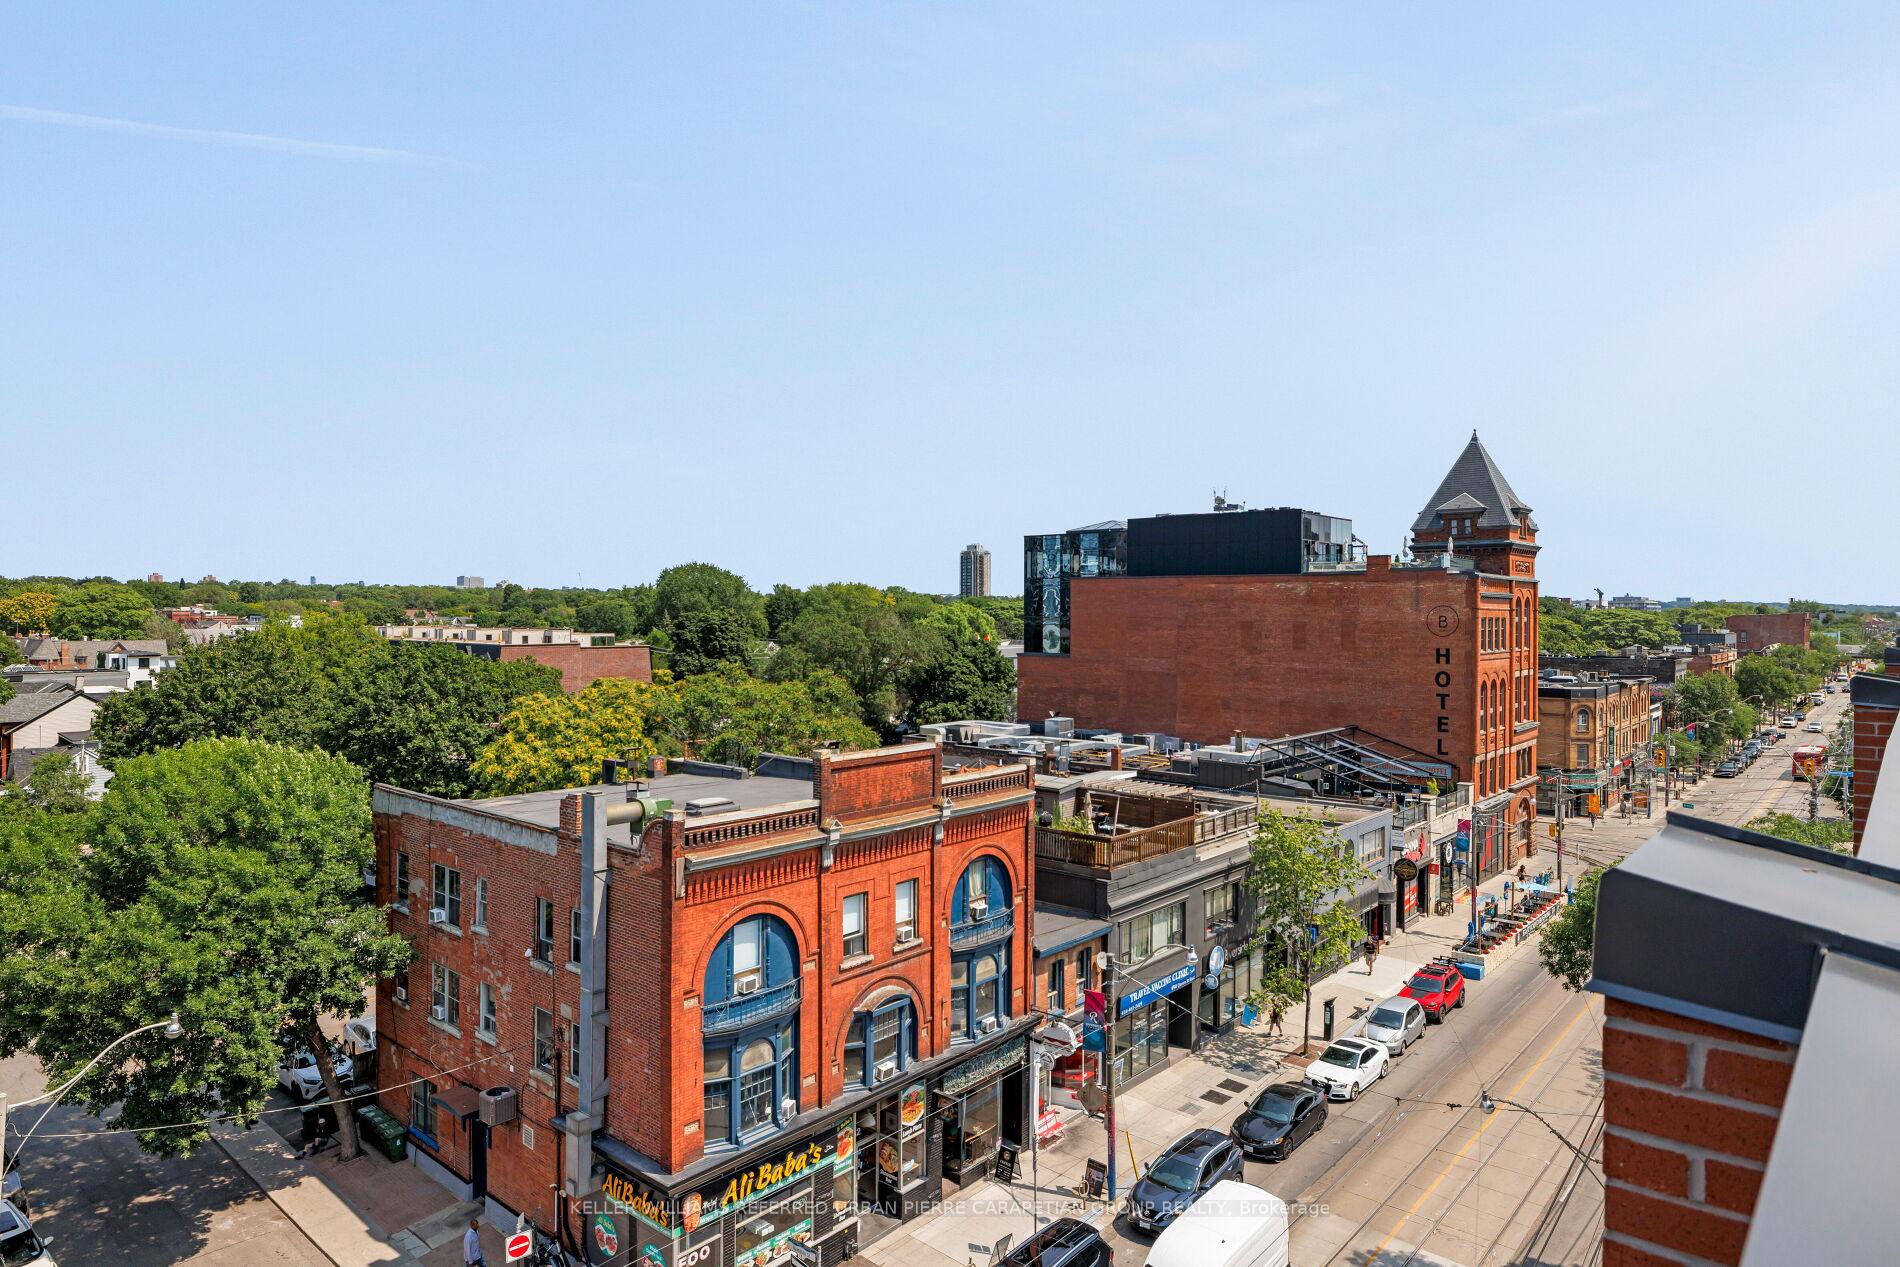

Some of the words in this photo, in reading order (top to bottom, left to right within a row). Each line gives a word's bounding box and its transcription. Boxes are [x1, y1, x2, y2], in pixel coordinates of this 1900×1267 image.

[1438, 615, 1448, 629] B
[1434, 647, 1451, 756] HOTEL
[1129, 985, 1151, 1003] TRAVEL
[1151, 974, 1172, 993] VACCINE
[1172, 966, 1189, 982] CLINIC
[601, 1173, 623, 1200] Ali
[621, 1180, 669, 1227] Baba's
[720, 1171, 756, 1209] Ali
[755, 1141, 823, 1191] Baba's
